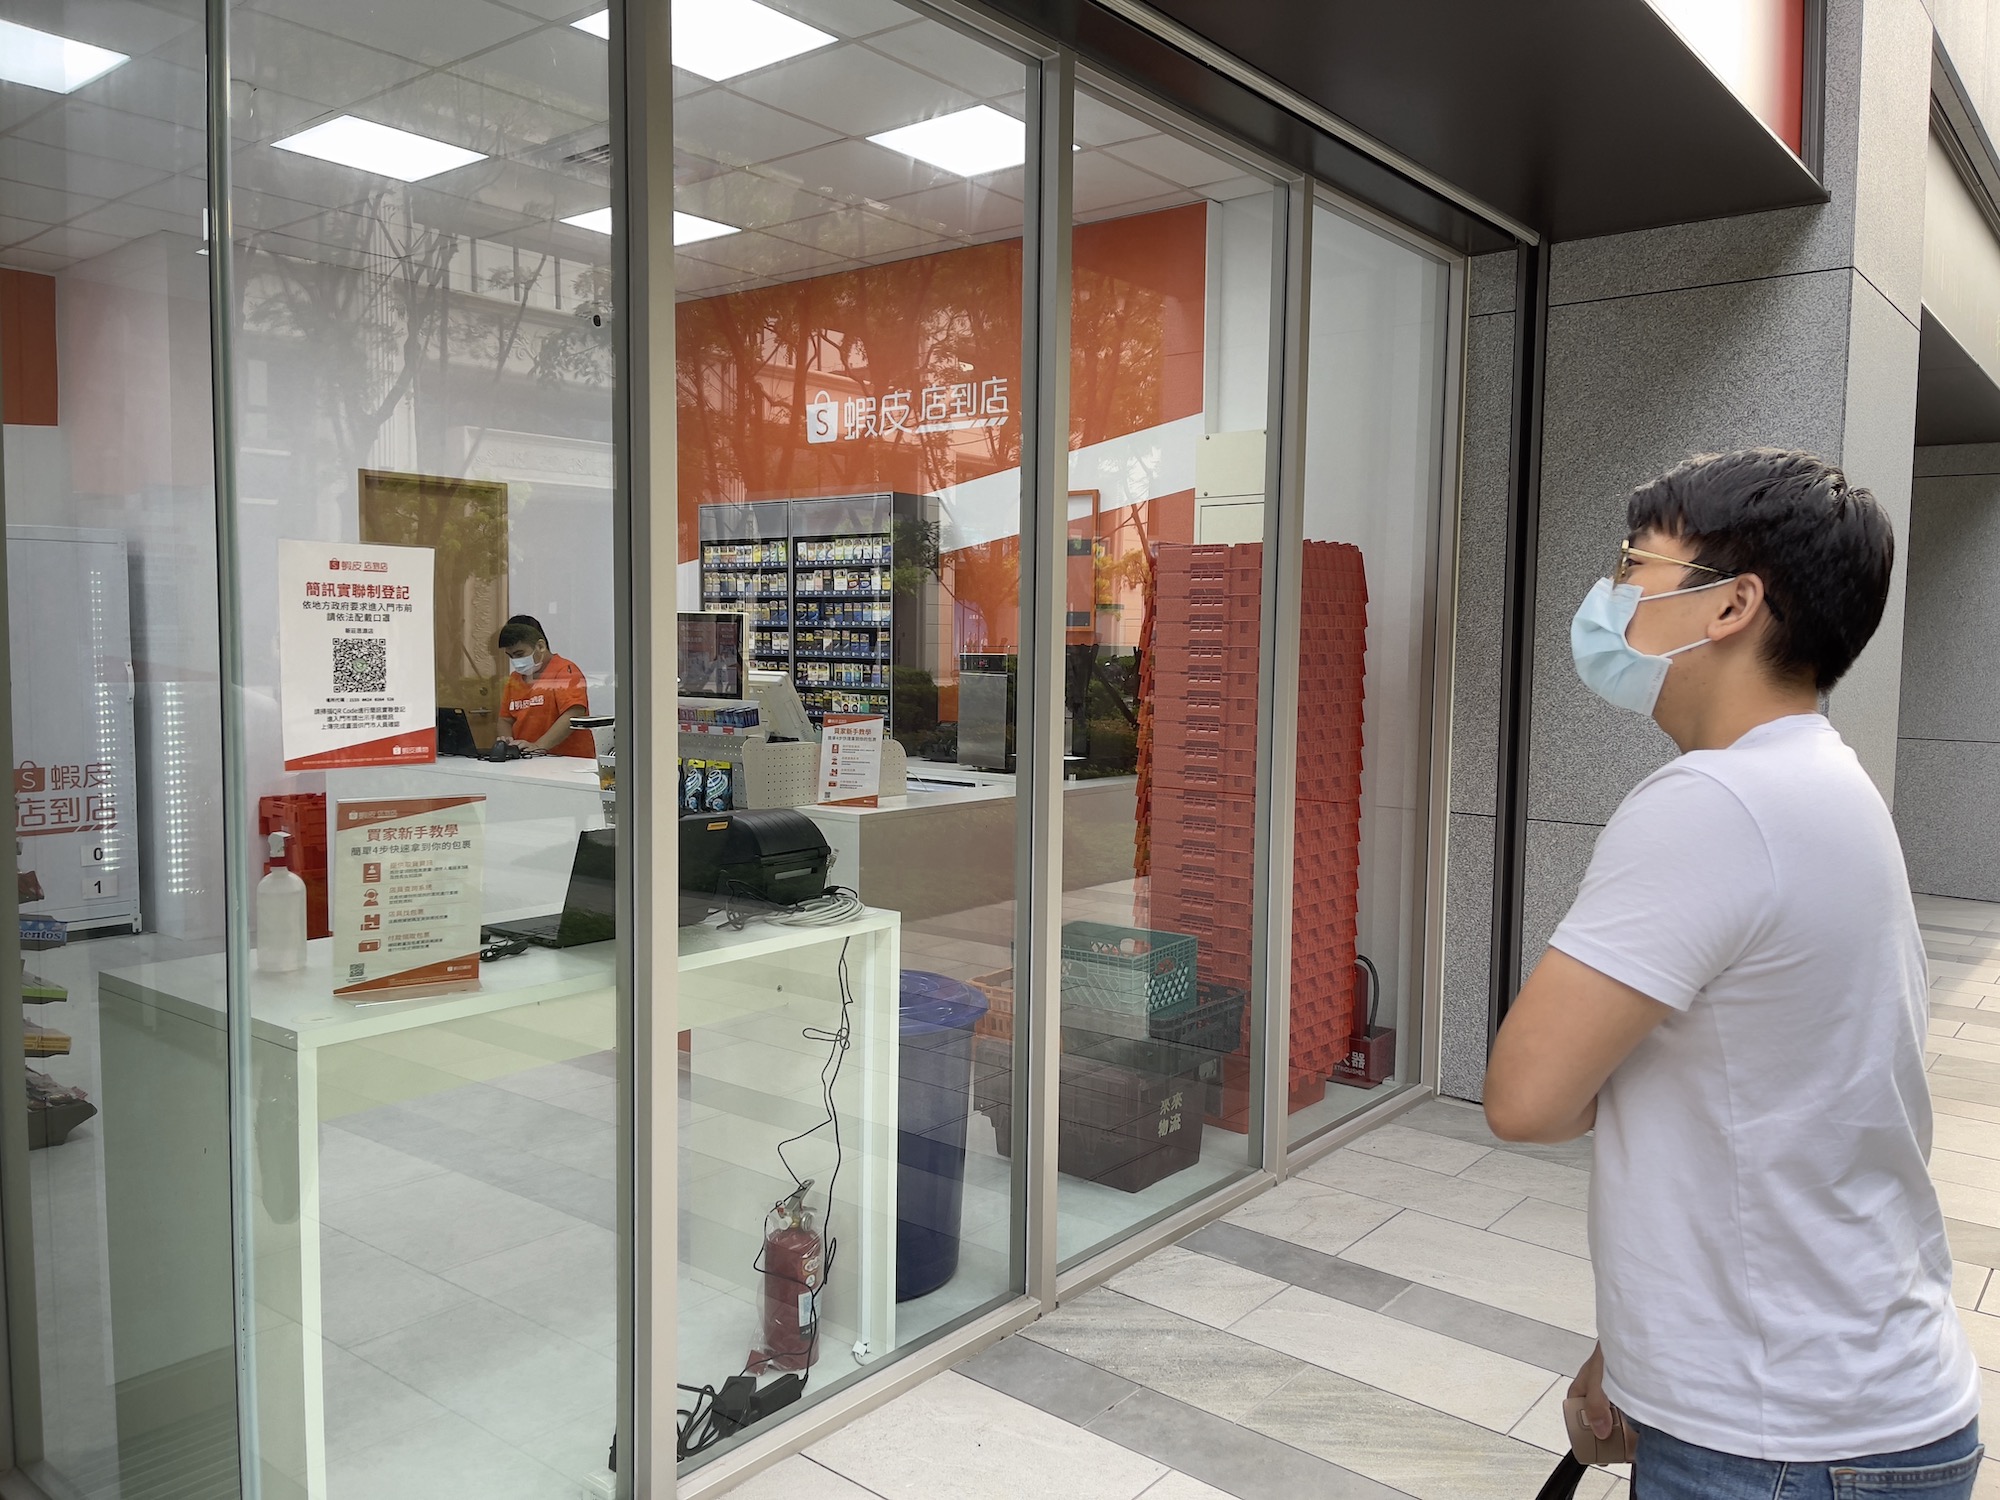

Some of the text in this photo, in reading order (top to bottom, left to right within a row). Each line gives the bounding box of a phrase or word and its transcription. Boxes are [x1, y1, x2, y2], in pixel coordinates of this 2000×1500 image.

[843, 391, 913, 440] 蝦皮
[919, 375, 1009, 421] 店到店
[306, 582, 410, 600] 簡訊實聯制登記
[302, 601, 413, 612] 依地方政府要求進入門市前
[327, 612, 390, 623] 請依法配戴口罩
[51, 762, 112, 791] 蝦皮
[16, 792, 116, 827] 店到店
[367, 824, 459, 842] 買家新手教學
[93, 847, 104, 861] 0
[351, 840, 472, 856] 簡單4步快速拿到你的包裹
[94, 880, 102, 894] 1
